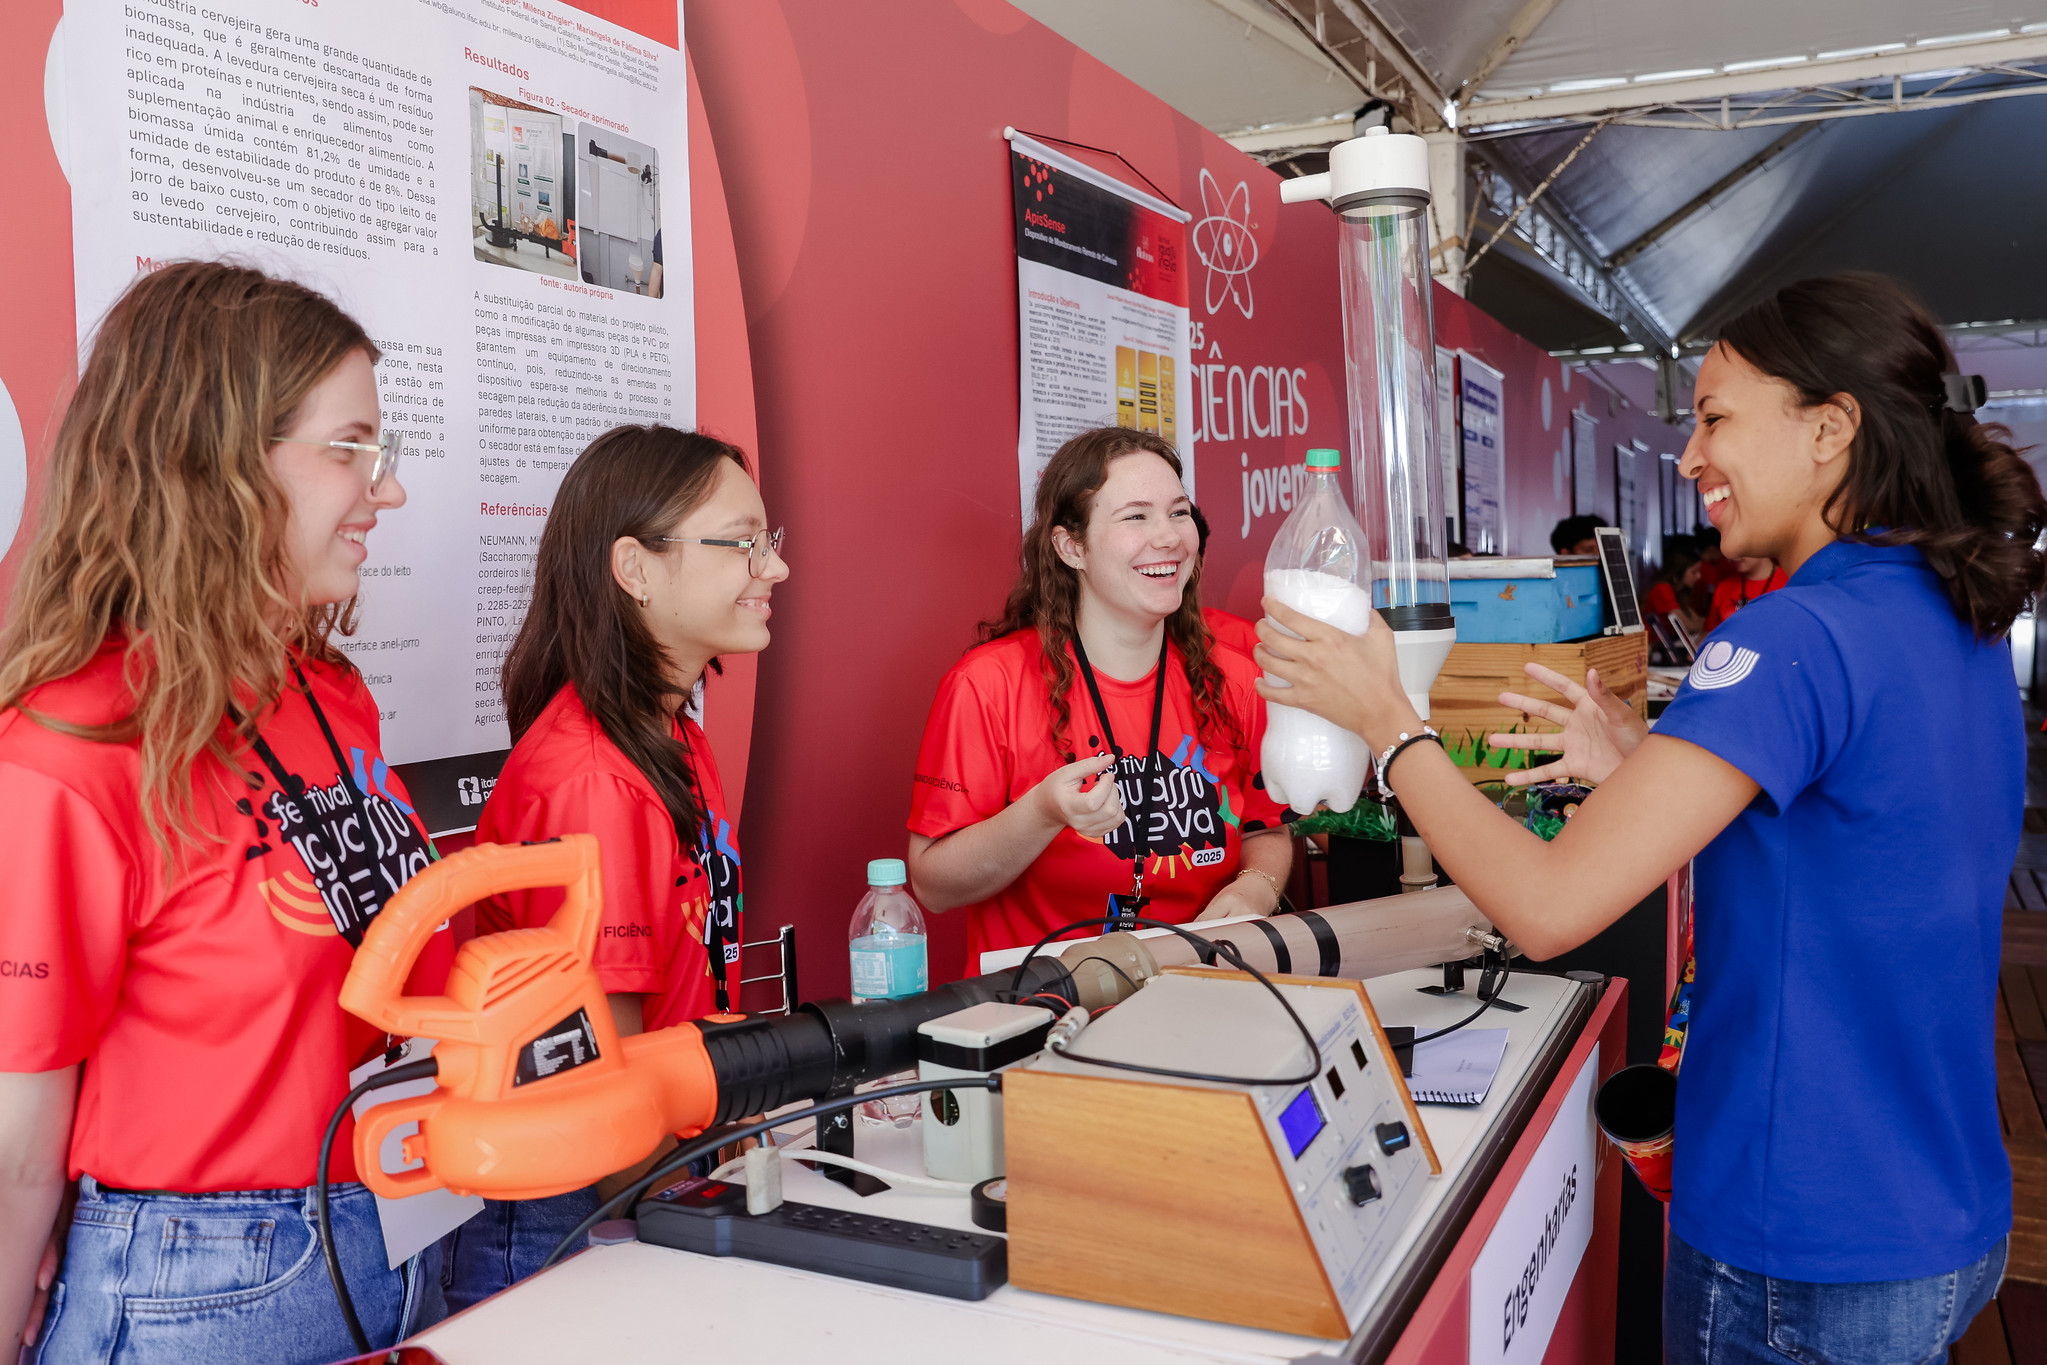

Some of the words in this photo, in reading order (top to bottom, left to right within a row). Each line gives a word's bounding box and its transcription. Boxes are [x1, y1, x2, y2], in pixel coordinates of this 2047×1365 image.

[124, 4, 194, 36] biomassa,
[203, 28, 227, 43] que
[234, 35, 242, 47] é
[250, 42, 316, 68] geralmente
[322, 61, 380, 87] descartada
[386, 81, 399, 93] de
[404, 85, 433, 103] forma
[612, 37, 620, 46] de
[125, 24, 208, 57] inadequada.
[213, 49, 223, 61] A
[226, 52, 279, 76] levedura
[283, 69, 337, 92] cervejeira
[340, 86, 365, 100] seca
[368, 92, 375, 103] é
[378, 97, 395, 109] um
[397, 103, 433, 120] resíduo
[464, 46, 529, 80] Resultados
[126, 68, 185, 90] aplicada
[206, 87, 222, 99] na
[242, 93, 294, 117] indústria
[312, 112, 326, 125] de
[342, 121, 393, 143] alimentos
[407, 139, 434, 154] como
[518, 86, 543, 103] Figura
[544, 96, 554, 107] 02
[560, 101, 590, 118] Secador
[591, 114, 629, 133] aprimorado
[127, 88, 231, 120] suplementação
[235, 113, 278, 131] animal
[281, 124, 289, 134] e
[293, 127, 364, 152] enriquecedor
[368, 145, 424, 168] alimentício.
[427, 160, 435, 171] A
[129, 129, 189, 150] umidade
[194, 141, 210, 154] de
[215, 147, 290, 171] estabilidade
[294, 162, 310, 175] do
[313, 168, 356, 185] produto
[359, 176, 365, 188] é
[369, 180, 381, 192] de
[384, 183, 403, 197] 8%.
[406, 188, 436, 205] Dessa
[131, 190, 149, 202] ao
[160, 192, 205, 211] levedo
[215, 205, 280, 226] cervejeiro,
[289, 218, 358, 239] contribuindo
[366, 233, 396, 247] assim
[403, 241, 425, 253] para
[432, 247, 438, 255] a
[132, 210, 243, 237] sustentabilidade
[246, 229, 253, 238] e
[256, 231, 304, 247] redução
[306, 238, 320, 250] de
[323, 243, 370, 259] resíduos.
[1025, 208, 1066, 234] ApisSense
[539, 276, 562, 289] fonte:
[563, 283, 588, 294] autoria
[588, 288, 614, 300] própria
[474, 308, 498, 320] como
[502, 313, 507, 322] a
[511, 315, 560, 331] modificação
[562, 322, 572, 332] de
[575, 325, 605, 338] algumas
[607, 332, 628, 343] peças
[631, 335, 640, 344] de
[642, 336, 656, 347] PVC
[658, 341, 670, 349] por
[475, 325, 501, 337] peças
[505, 327, 547, 343] impressas
[550, 337, 563, 346] em
[566, 337, 607, 353] impressora
[609, 345, 620, 355] 3D
[623, 347, 639, 358] (PLA
[649, 351, 671, 364] PETG),
[384, 358, 412, 371] cone,
[417, 362, 443, 373] nesta
[379, 373, 388, 386] já
[394, 376, 422, 388] estão
[428, 380, 444, 390] em
[477, 372, 523, 388] dispositivo
[529, 381, 569, 393] espera-se
[575, 386, 607, 397] melhoria
[613, 390, 623, 400] do
[628, 393, 658, 404] processo
[663, 398, 672, 406] de
[383, 391, 428, 405] cilíndrica
[432, 396, 444, 407] de
[391, 409, 409, 422] gás
[411, 413, 444, 424] quente
[478, 422, 516, 435] uniforme
[517, 427, 536, 437] para
[537, 428, 574, 441] obtenção
[575, 431, 585, 440] da
[479, 473, 520, 485] secagem.
[480, 502, 547, 516] Referências
[479, 535, 527, 546] NEUMANN,
[478, 567, 519, 578] cordeiros
[476, 615, 507, 627] PINTO,
[380, 637, 420, 650] anel-jorro
[272, 774, 352, 832] fetival
[1116, 766, 1206, 811] guassu
[1196, 851, 1222, 864] 2025
[1503, 1163, 1577, 1356] Engenharias
